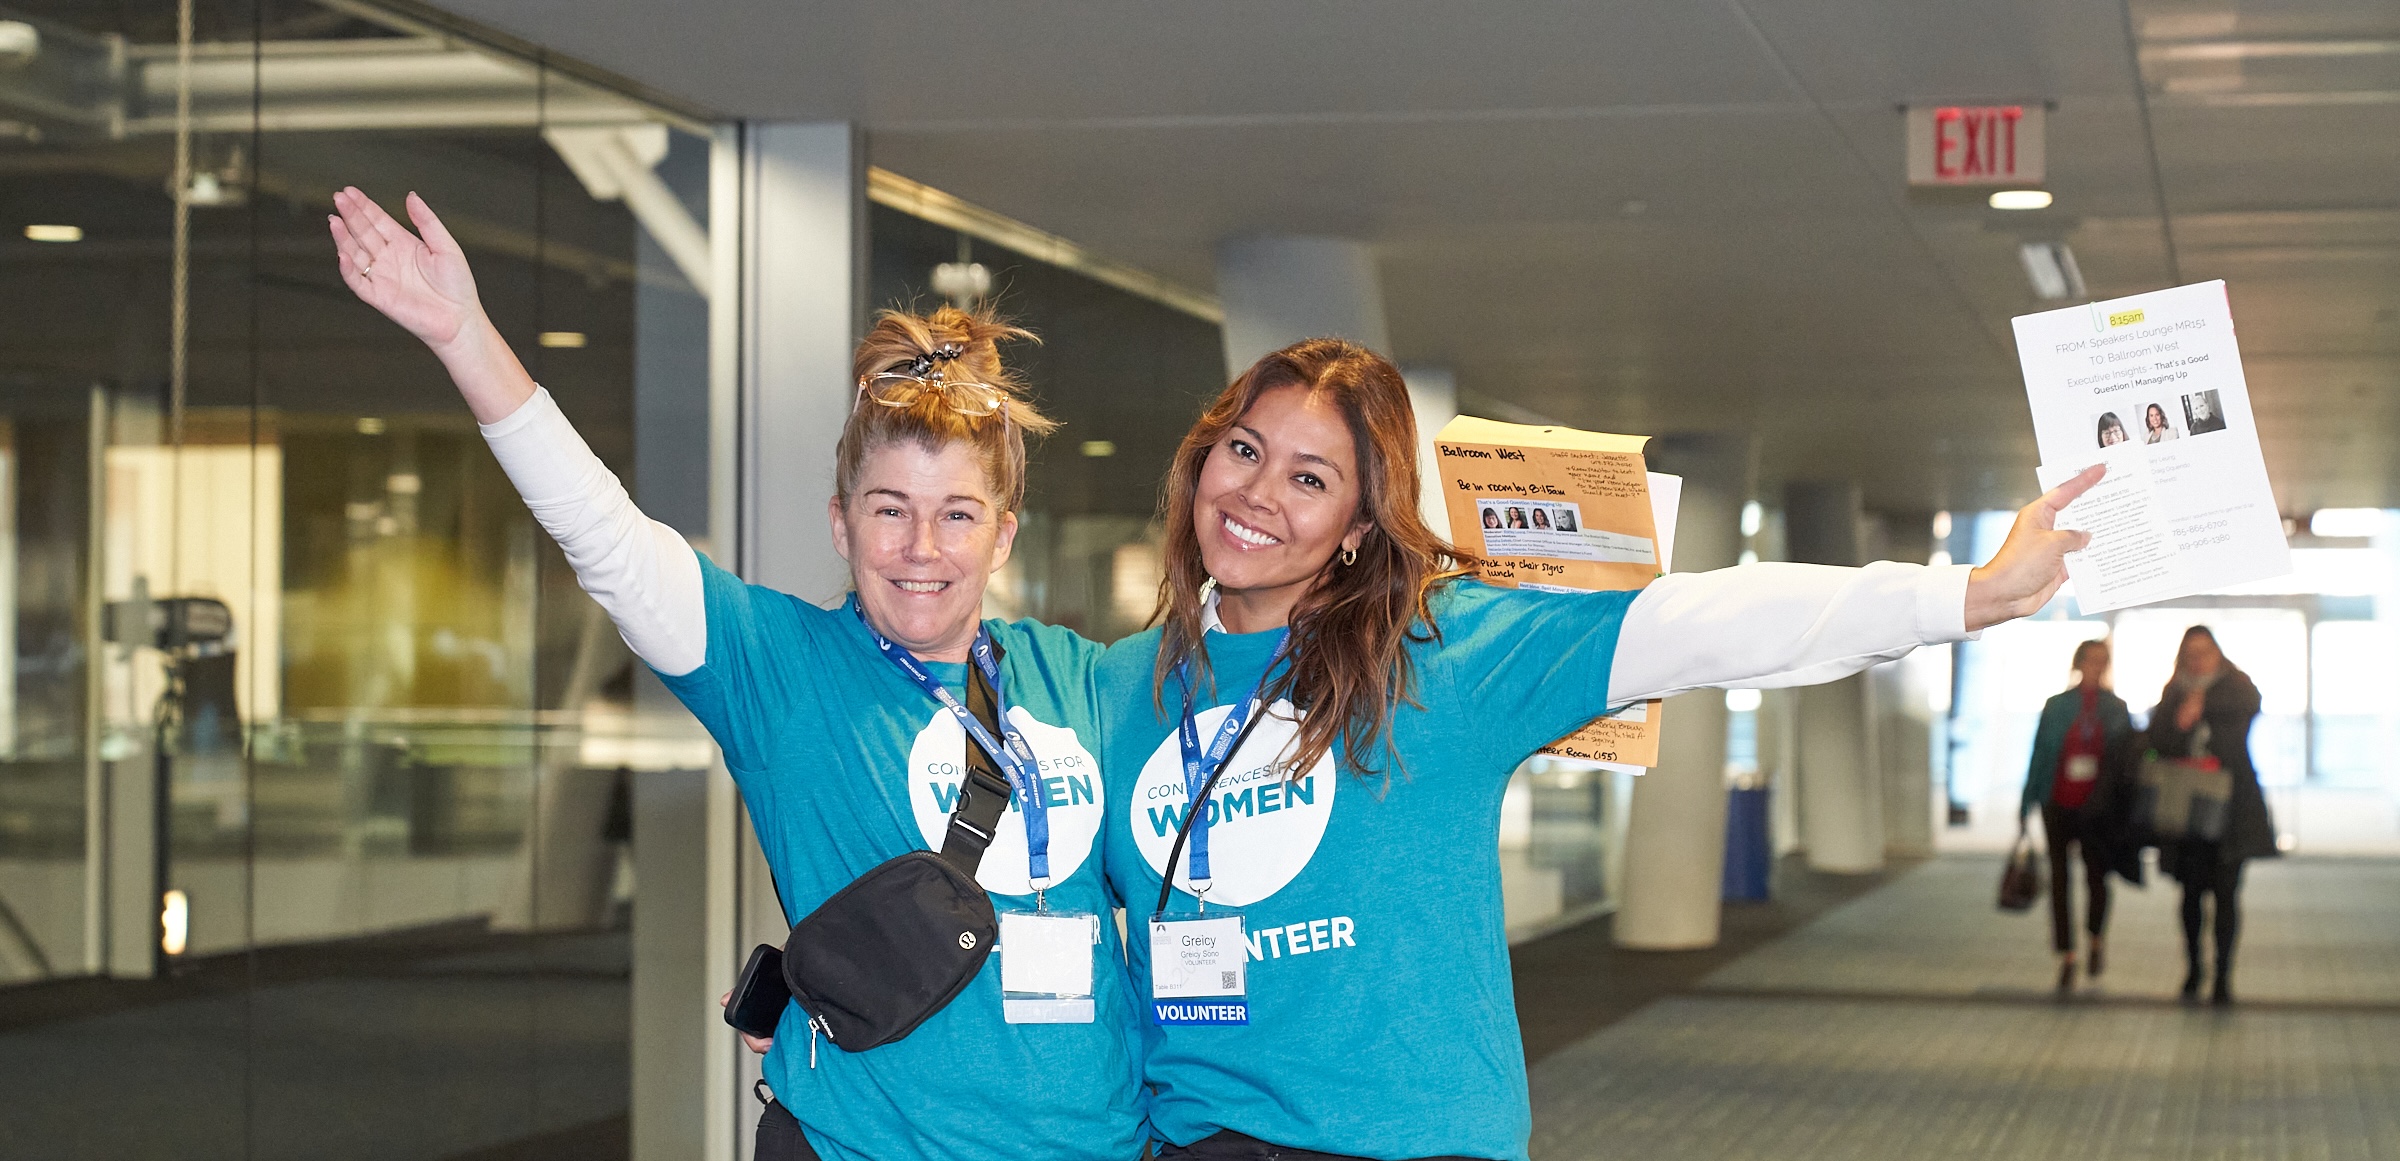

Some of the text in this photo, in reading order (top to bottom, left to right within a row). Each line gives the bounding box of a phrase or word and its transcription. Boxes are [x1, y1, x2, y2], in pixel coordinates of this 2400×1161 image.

[1935, 107, 2023, 177] EXIT
[2110, 311, 2145, 326] 8:15am
[2089, 331, 2135, 349] Speakers
[2136, 325, 2174, 341] Lounge
[2175, 319, 2206, 333] MR151
[2108, 346, 2152, 364] Ballroom
[2153, 340, 2180, 354] West
[2067, 371, 2111, 388] Executive
[2112, 364, 2147, 380] Insights
[2154, 358, 2180, 371] That's
[2187, 353, 2209, 365] Good
[2093, 381, 2130, 395] Question
[2135, 374, 2175, 388] Managing
[2176, 370, 2188, 381] Up
[1441, 445, 1525, 462] Ballroom West
[1457, 479, 1566, 496] Be in room by 8:15am
[2171, 519, 2228, 537] 785-865-6700
[1480, 559, 1501, 568] Pick
[1504, 561, 1516, 570] up
[1519, 559, 1539, 570] chair
[1487, 569, 1515, 578] lunch
[1054, 755, 1086, 770] FOR
[1566, 747, 1591, 758] Room
[1593, 751, 1618, 761] (155)
[1147, 766, 1271, 800] CONRENCES
[929, 774, 1095, 814] WEN
[1181, 935, 1217, 948] Greicy
[1244, 916, 1356, 962] NTEER
[1181, 951, 1201, 959] Greicy
[1156, 1005, 1247, 1021] VOLUNTEER
